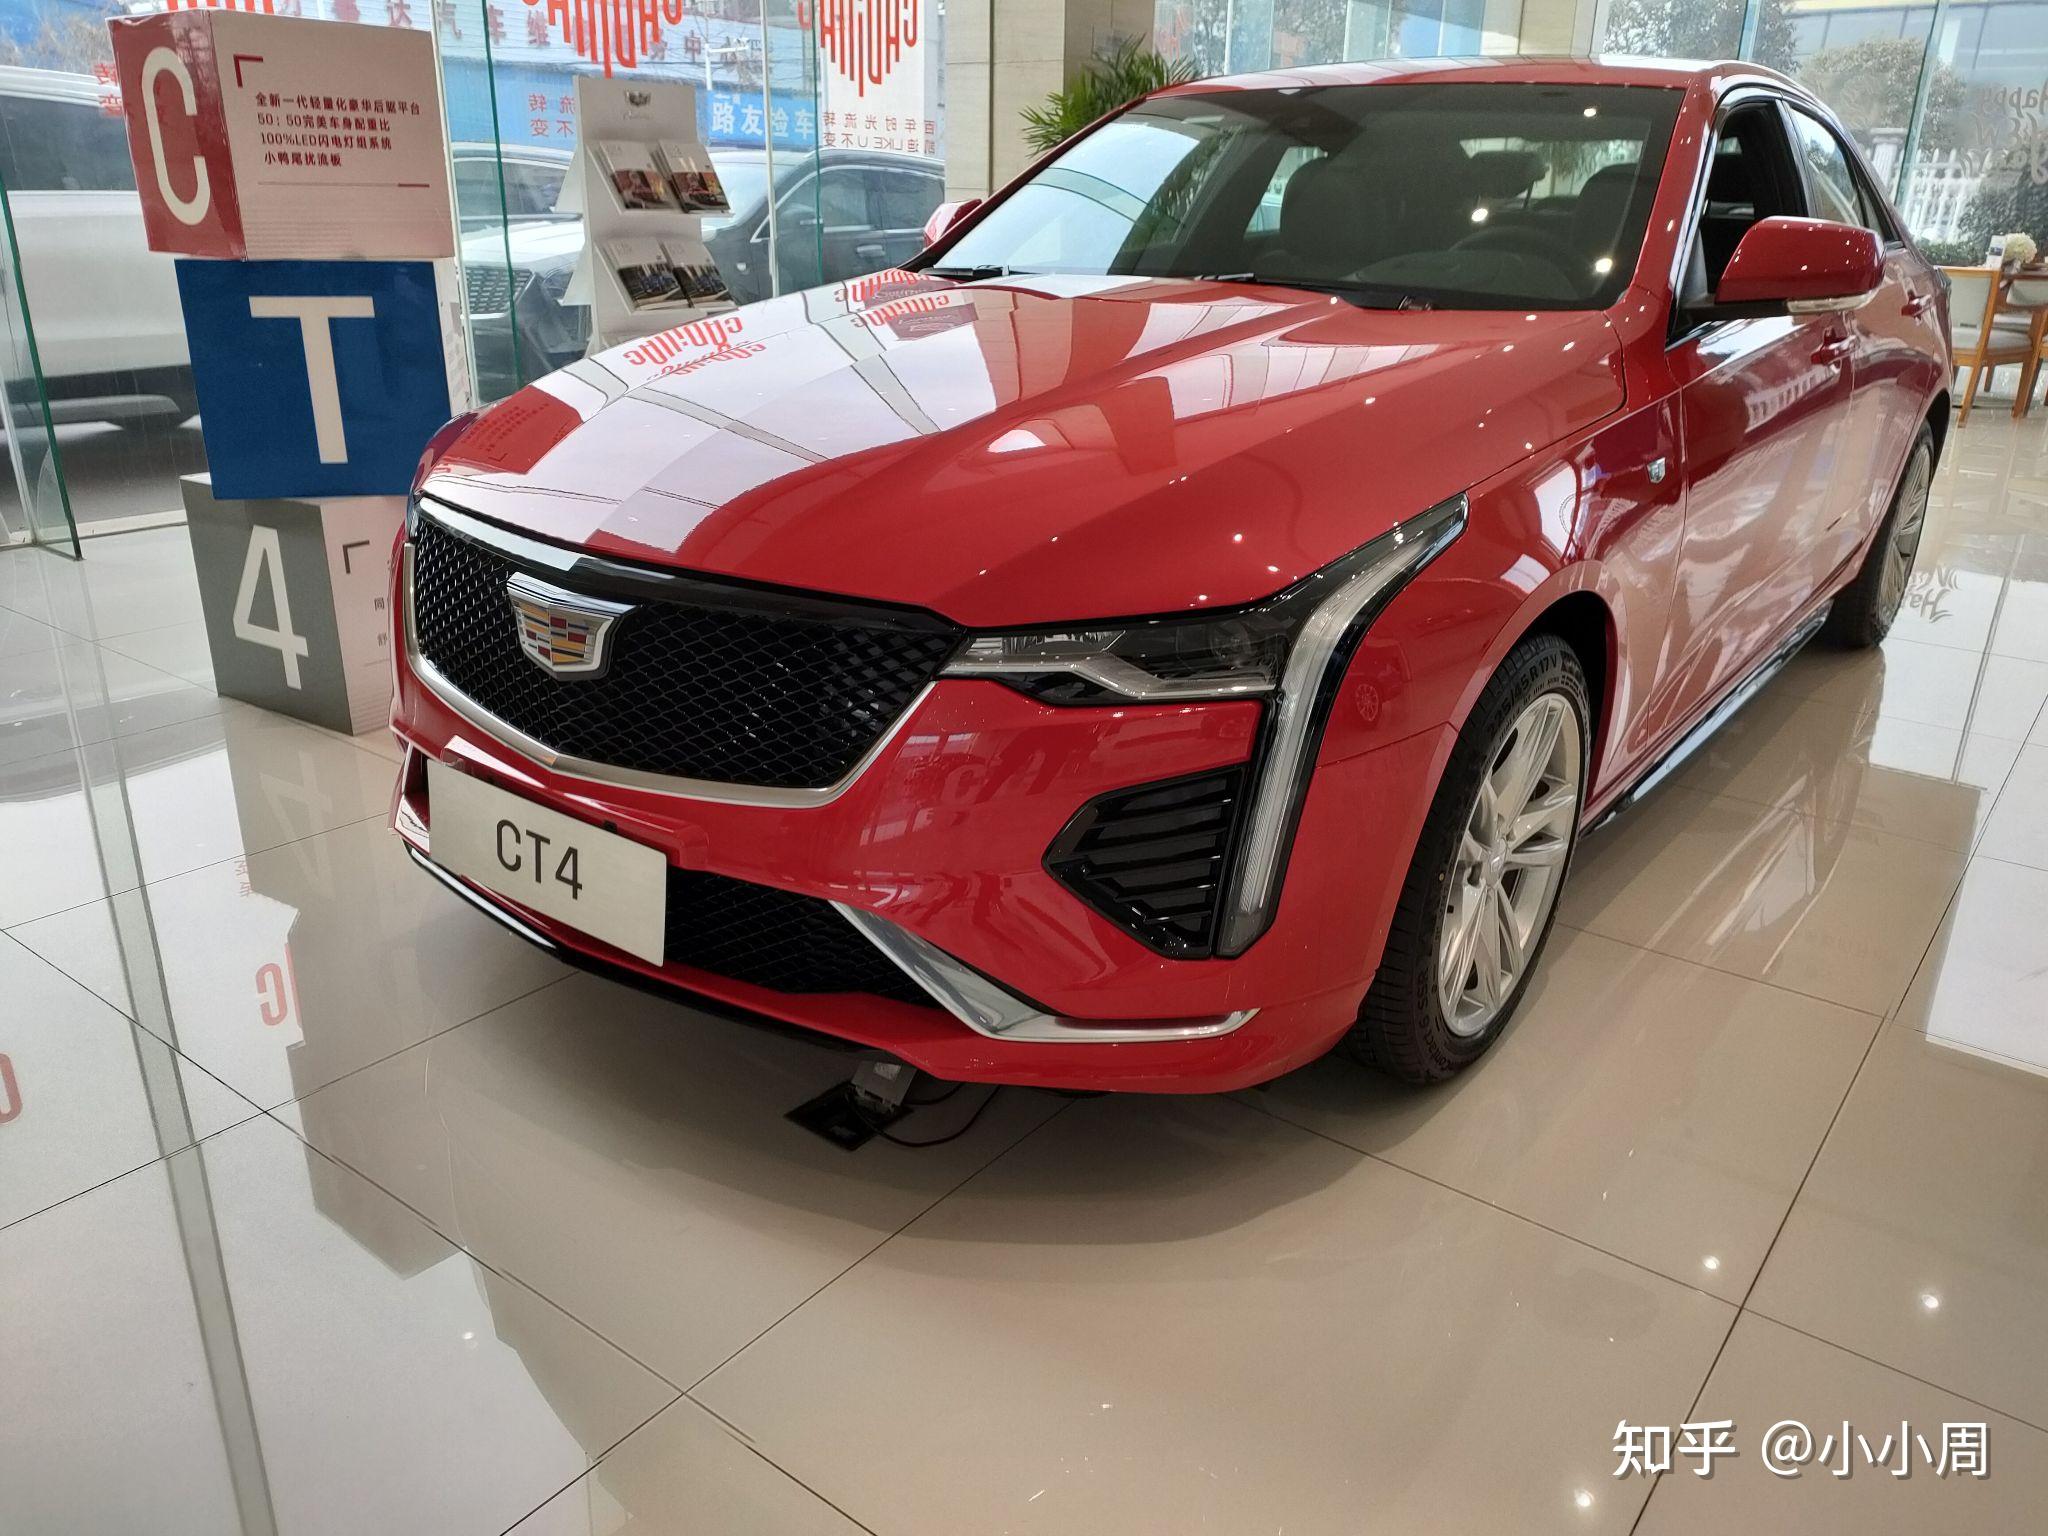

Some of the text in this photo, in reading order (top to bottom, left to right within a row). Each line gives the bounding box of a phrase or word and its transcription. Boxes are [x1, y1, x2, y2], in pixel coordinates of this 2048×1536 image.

[141, 47, 211, 226] C
[256, 91, 420, 115] 全新一代轻量化豪华后驱平台
[261, 132, 392, 150] 100%LED闪电灯组系统
[264, 151, 342, 167] 小鸭尾扰流板
[249, 296, 376, 464] T
[232, 524, 309, 690] 4
[496, 819, 583, 901] CT4
